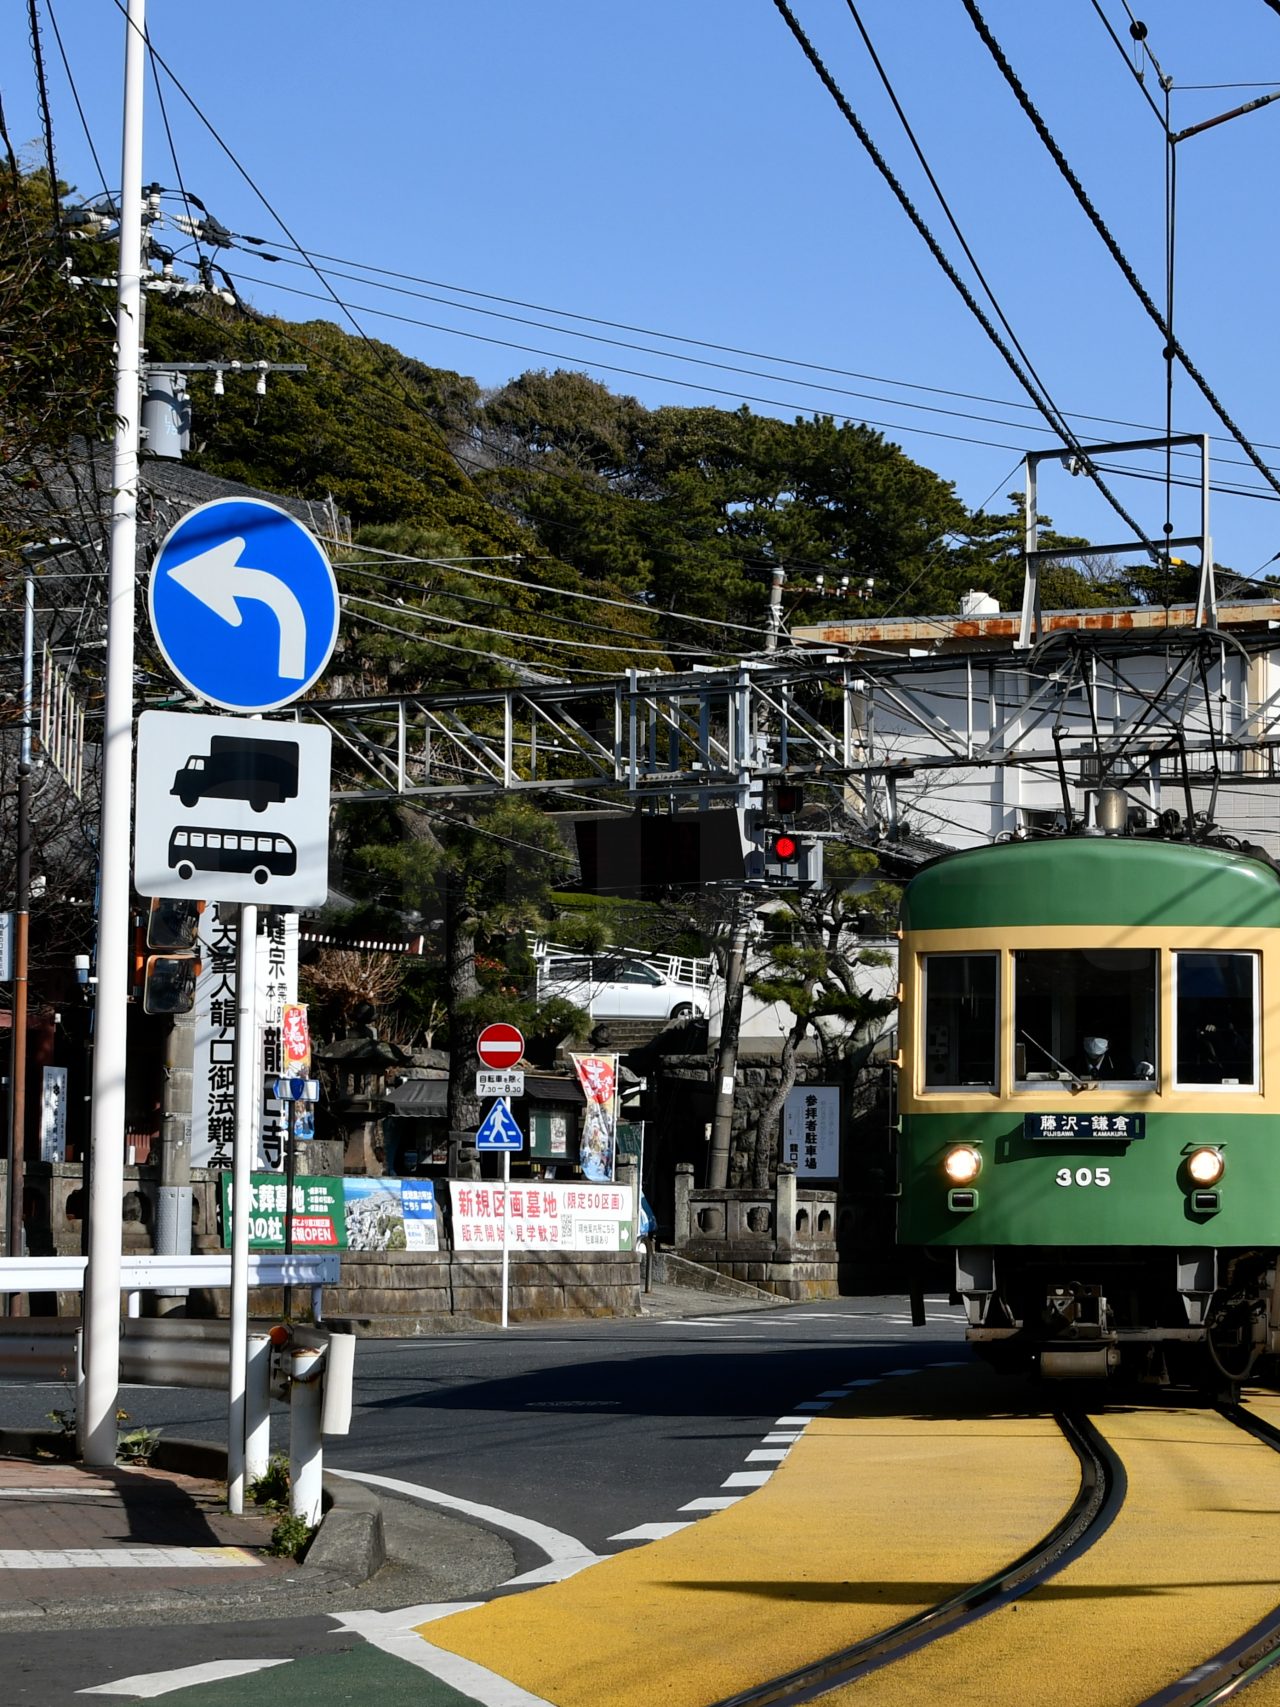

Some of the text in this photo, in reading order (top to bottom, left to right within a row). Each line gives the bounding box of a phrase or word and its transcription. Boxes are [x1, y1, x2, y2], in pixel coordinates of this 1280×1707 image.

[479, 1075, 521, 1083] 自転車を除く
[804, 1094, 818, 1170] 参拝者駐車場
[1055, 1167, 1111, 1187] 305
[458, 1188, 558, 1219] 新規区画墓地
